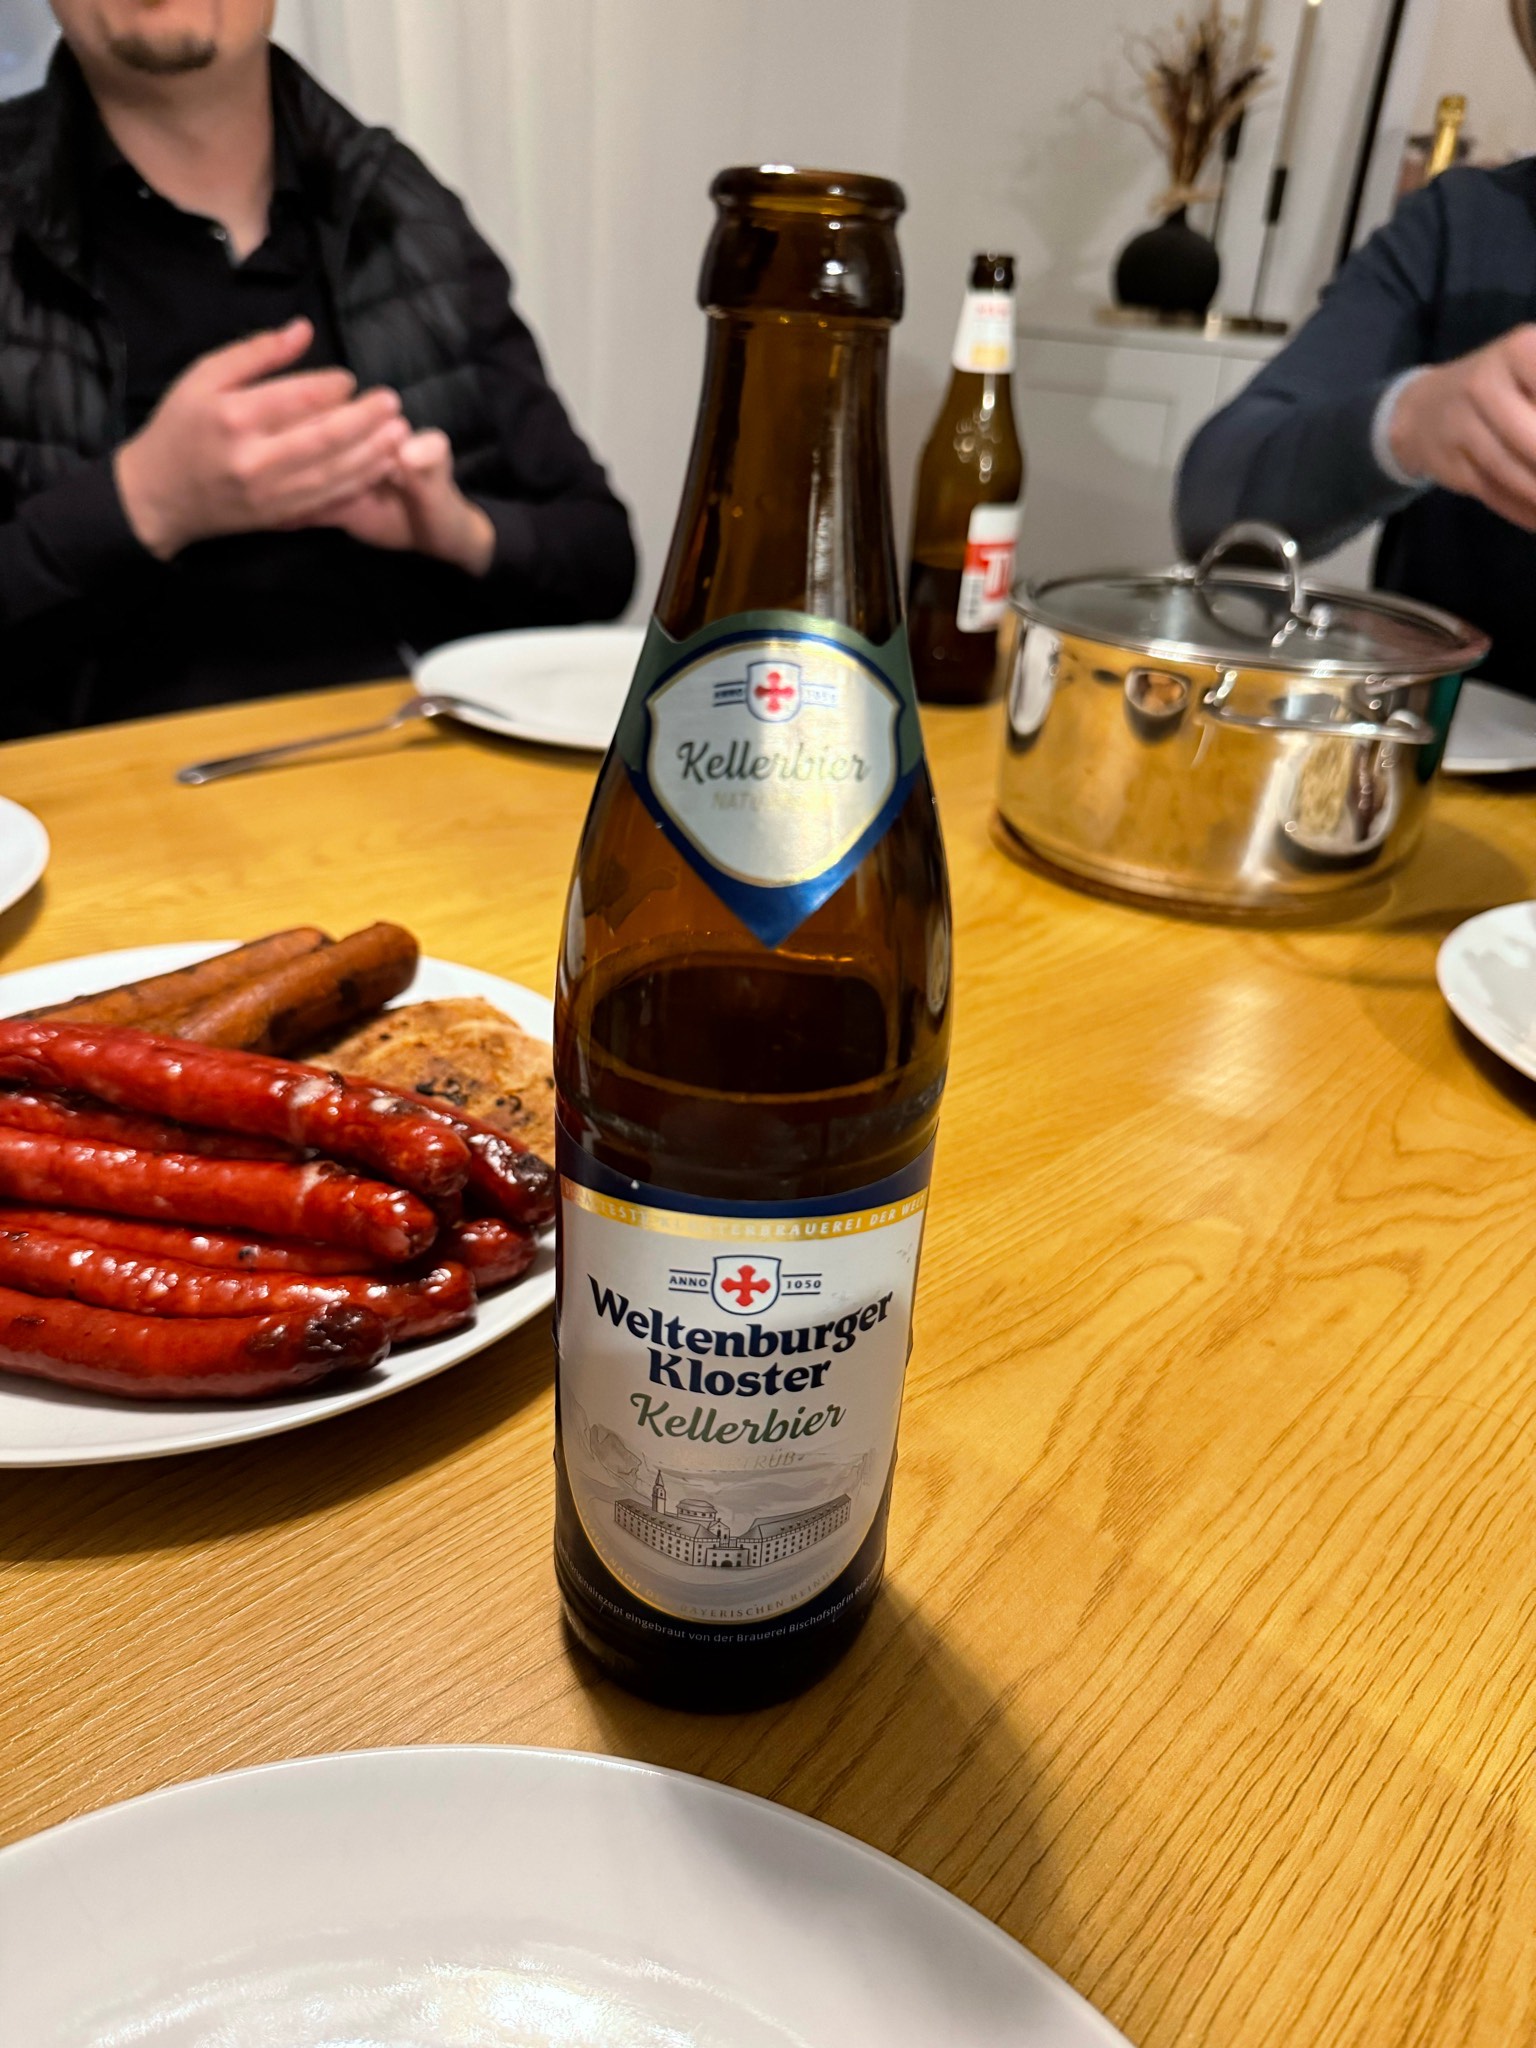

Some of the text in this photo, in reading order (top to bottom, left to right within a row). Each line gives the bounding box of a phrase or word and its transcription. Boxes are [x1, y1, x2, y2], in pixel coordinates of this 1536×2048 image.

[676, 739, 870, 785] Kellerbier
[869, 1209, 896, 1226] DER
[901, 1194, 925, 1216] WELT
[669, 1275, 822, 1289] ANNO 1050
[587, 1273, 893, 1358] Weltenburger
[647, 1347, 831, 1397] Kloster
[630, 1392, 847, 1444] Kellerbier
[625, 1611, 685, 1638] eingebraut
[689, 1632, 710, 1642] von
[713, 1633, 734, 1643] der
[736, 1626, 786, 1643] Brauerei
[789, 1596, 847, 1633] Bischofshof
[681, 1600, 784, 1618] BAYERISCHEN
